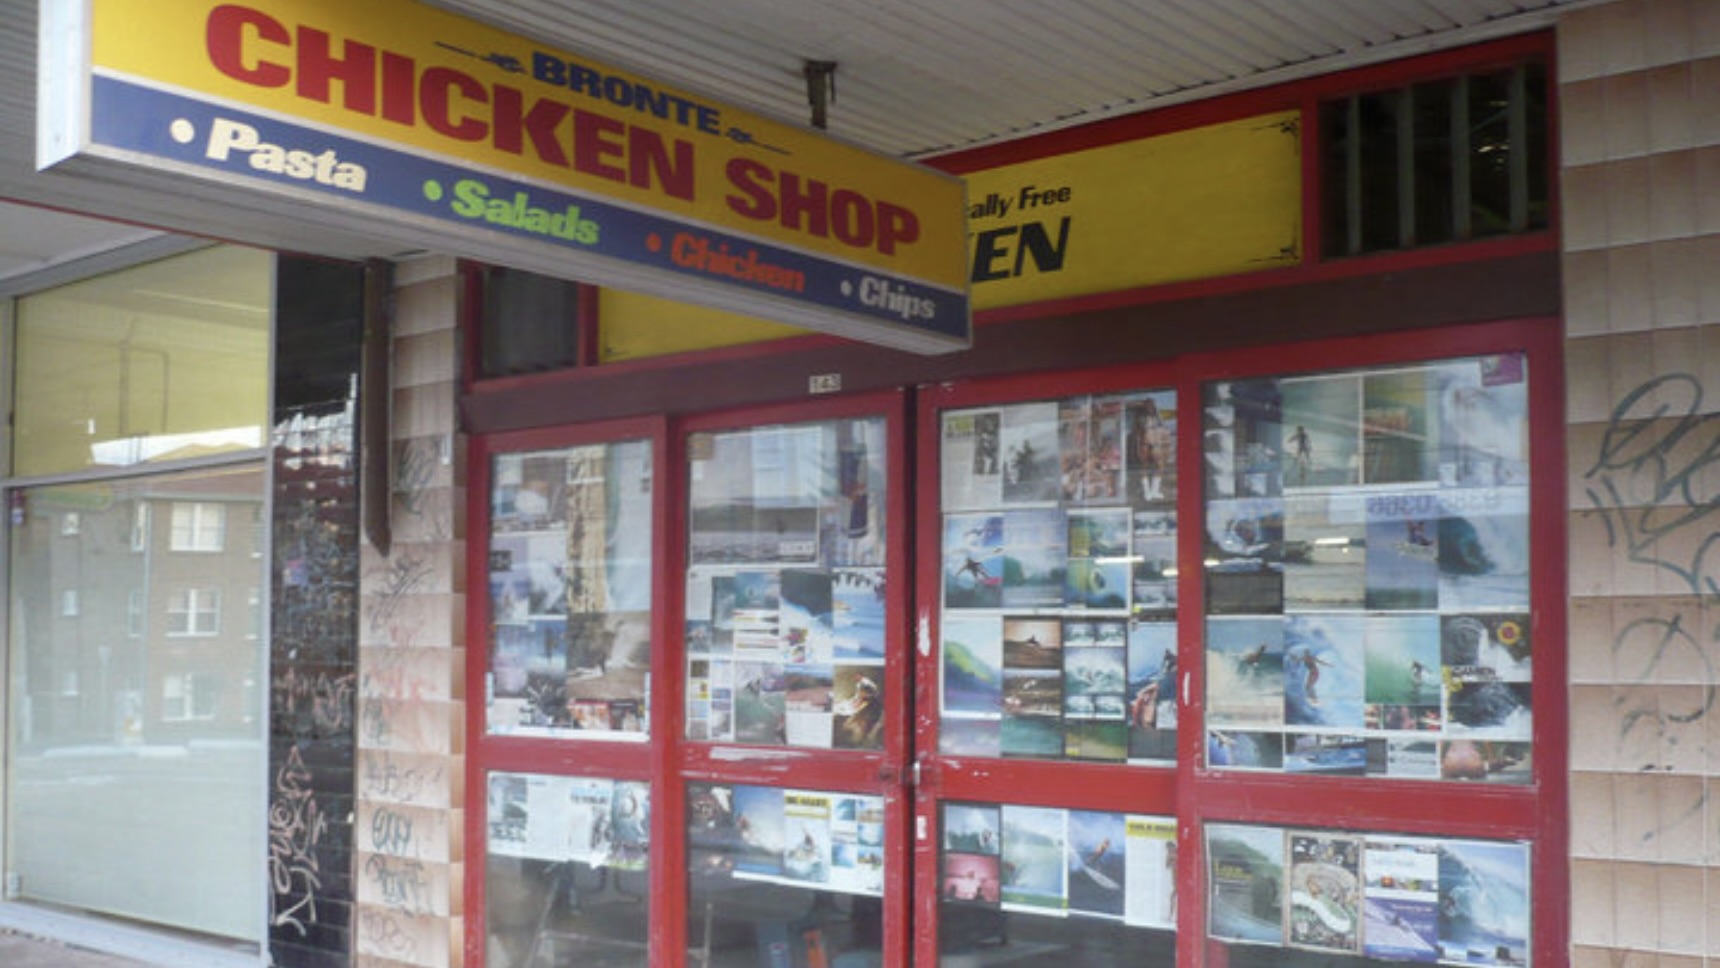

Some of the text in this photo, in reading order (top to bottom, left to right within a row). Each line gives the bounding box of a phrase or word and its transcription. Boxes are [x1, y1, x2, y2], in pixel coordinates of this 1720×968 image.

[532, 51, 721, 136] BRONTE
[205, 116, 368, 192] Pasta
[206, 4, 921, 256] CHICKEN SHOP
[452, 179, 599, 245] Salads
[968, 185, 1071, 219] ally Free
[671, 232, 805, 293] Chicken
[968, 216, 1071, 284] EN
[858, 275, 936, 319] Chips
